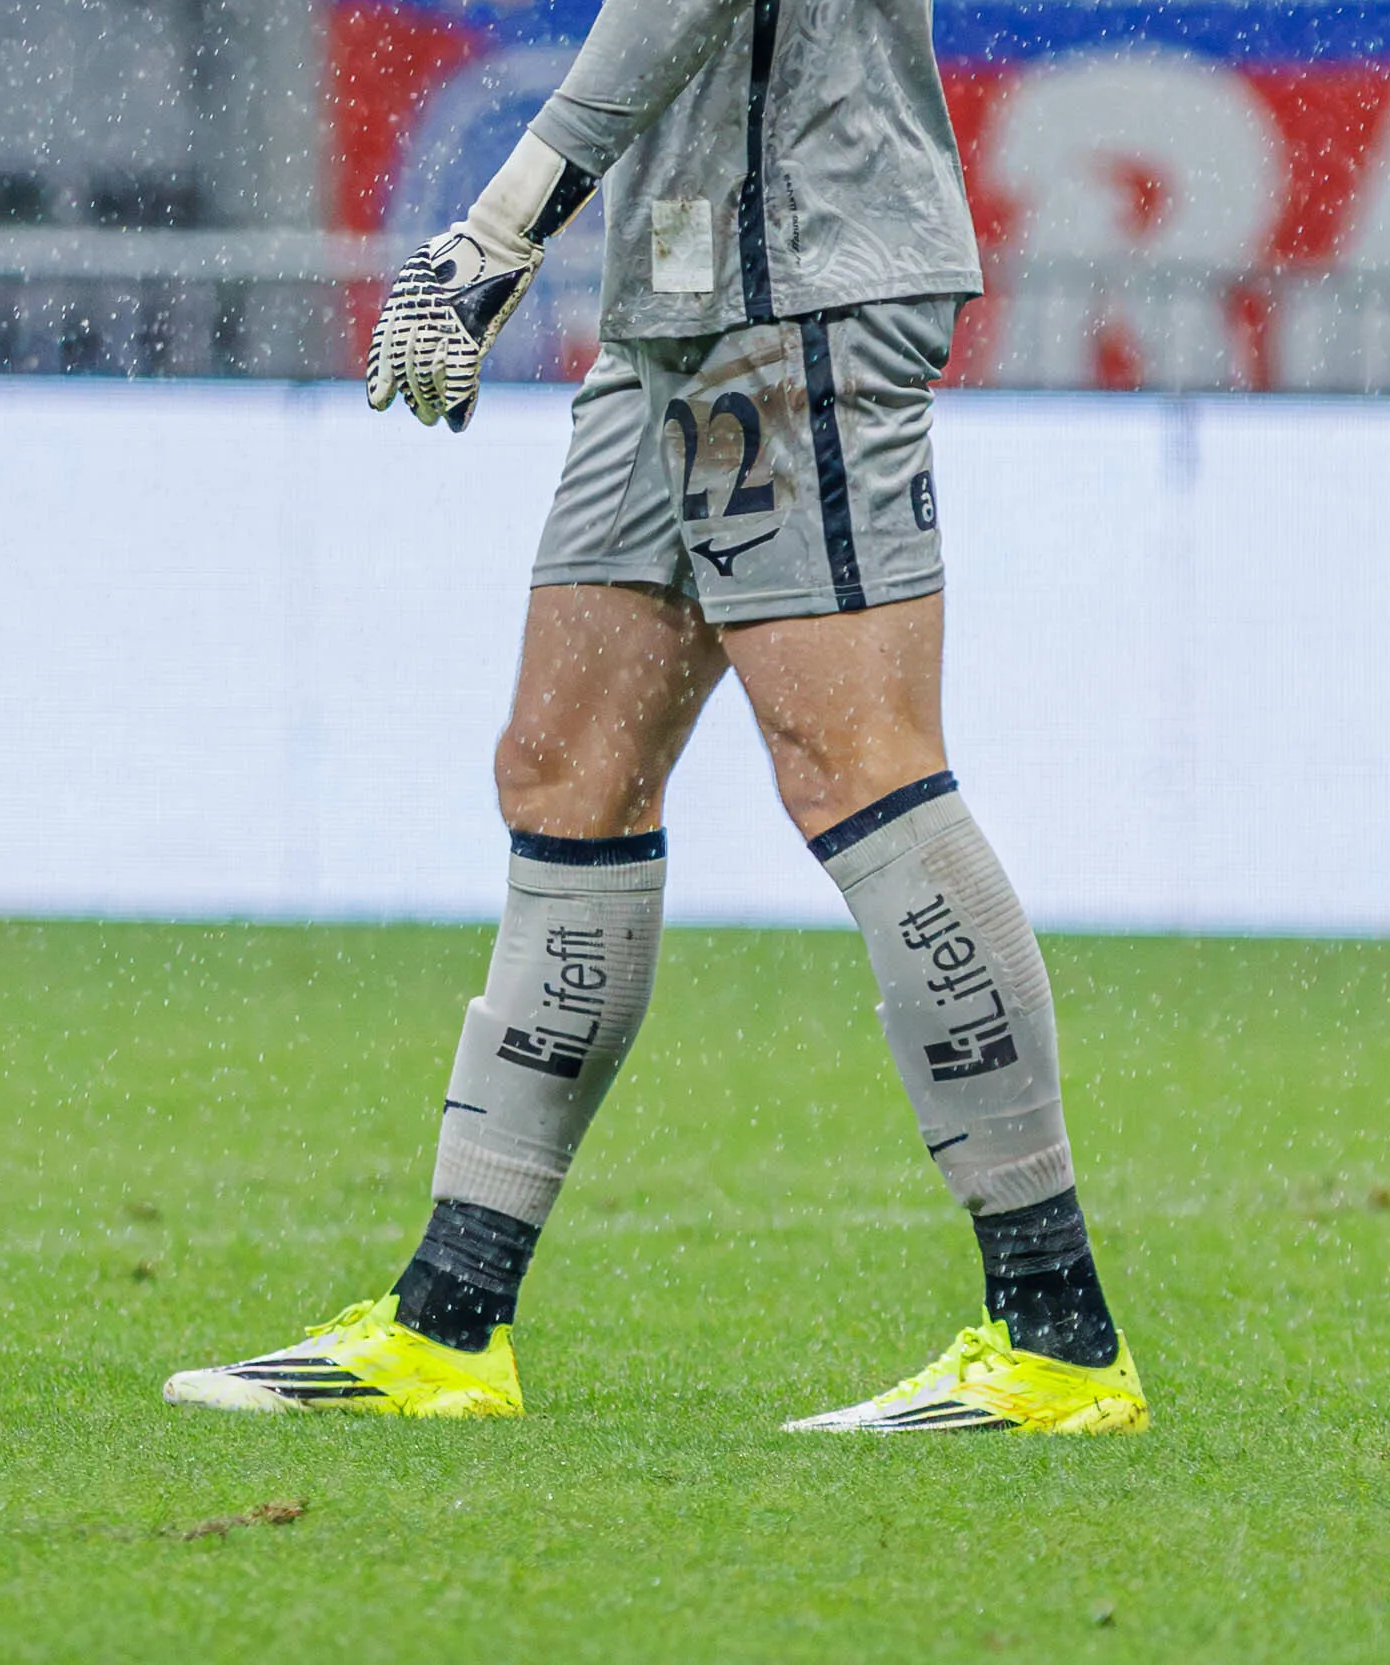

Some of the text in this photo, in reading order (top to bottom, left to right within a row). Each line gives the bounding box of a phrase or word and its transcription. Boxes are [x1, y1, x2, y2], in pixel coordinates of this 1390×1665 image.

[662, 391, 775, 522] 22
[535, 924, 608, 1046] Lifefit
[897, 892, 1006, 1035] Lifefit
